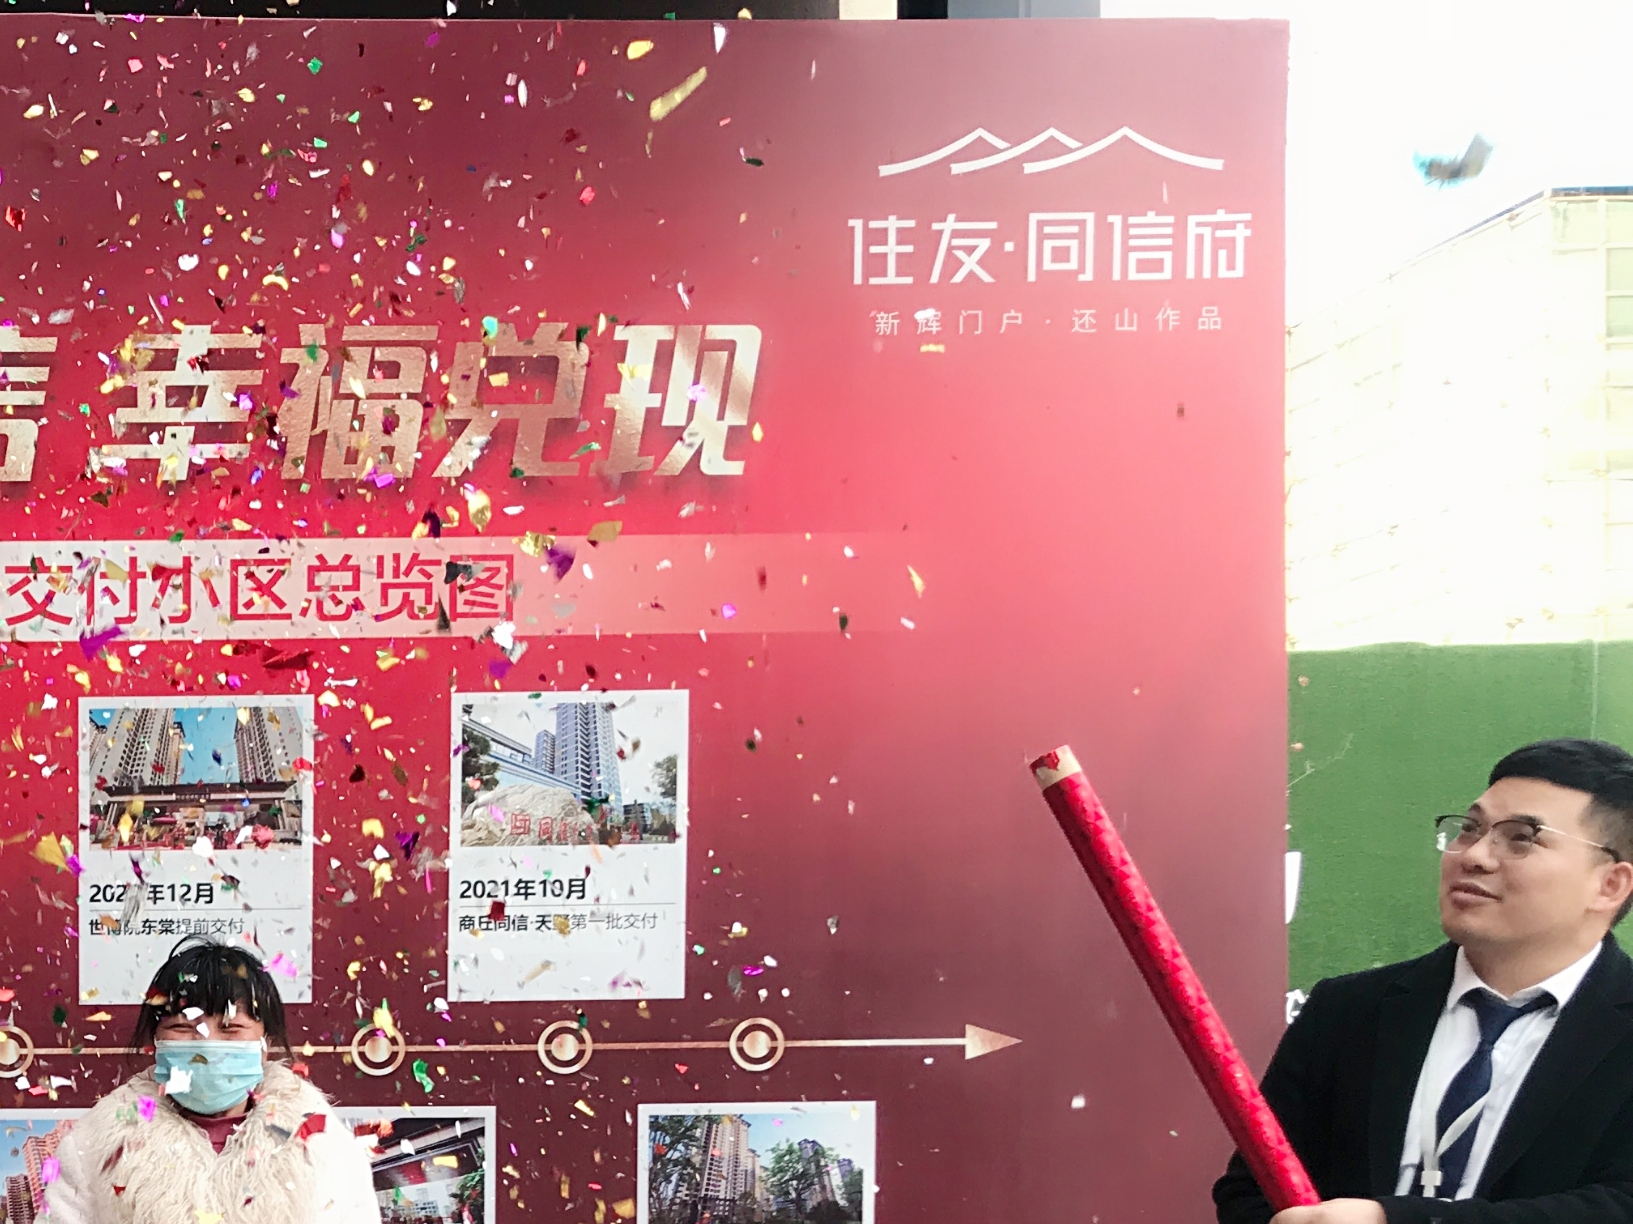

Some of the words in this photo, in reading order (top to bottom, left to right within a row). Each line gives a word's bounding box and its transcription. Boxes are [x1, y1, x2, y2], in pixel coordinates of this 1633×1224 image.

[847, 208, 1252, 286] 住友·同信府
[100, 323, 763, 481] 幸福兑现
[88, 882, 215, 905] 202年12月
[458, 877, 587, 900] 2021年10月
